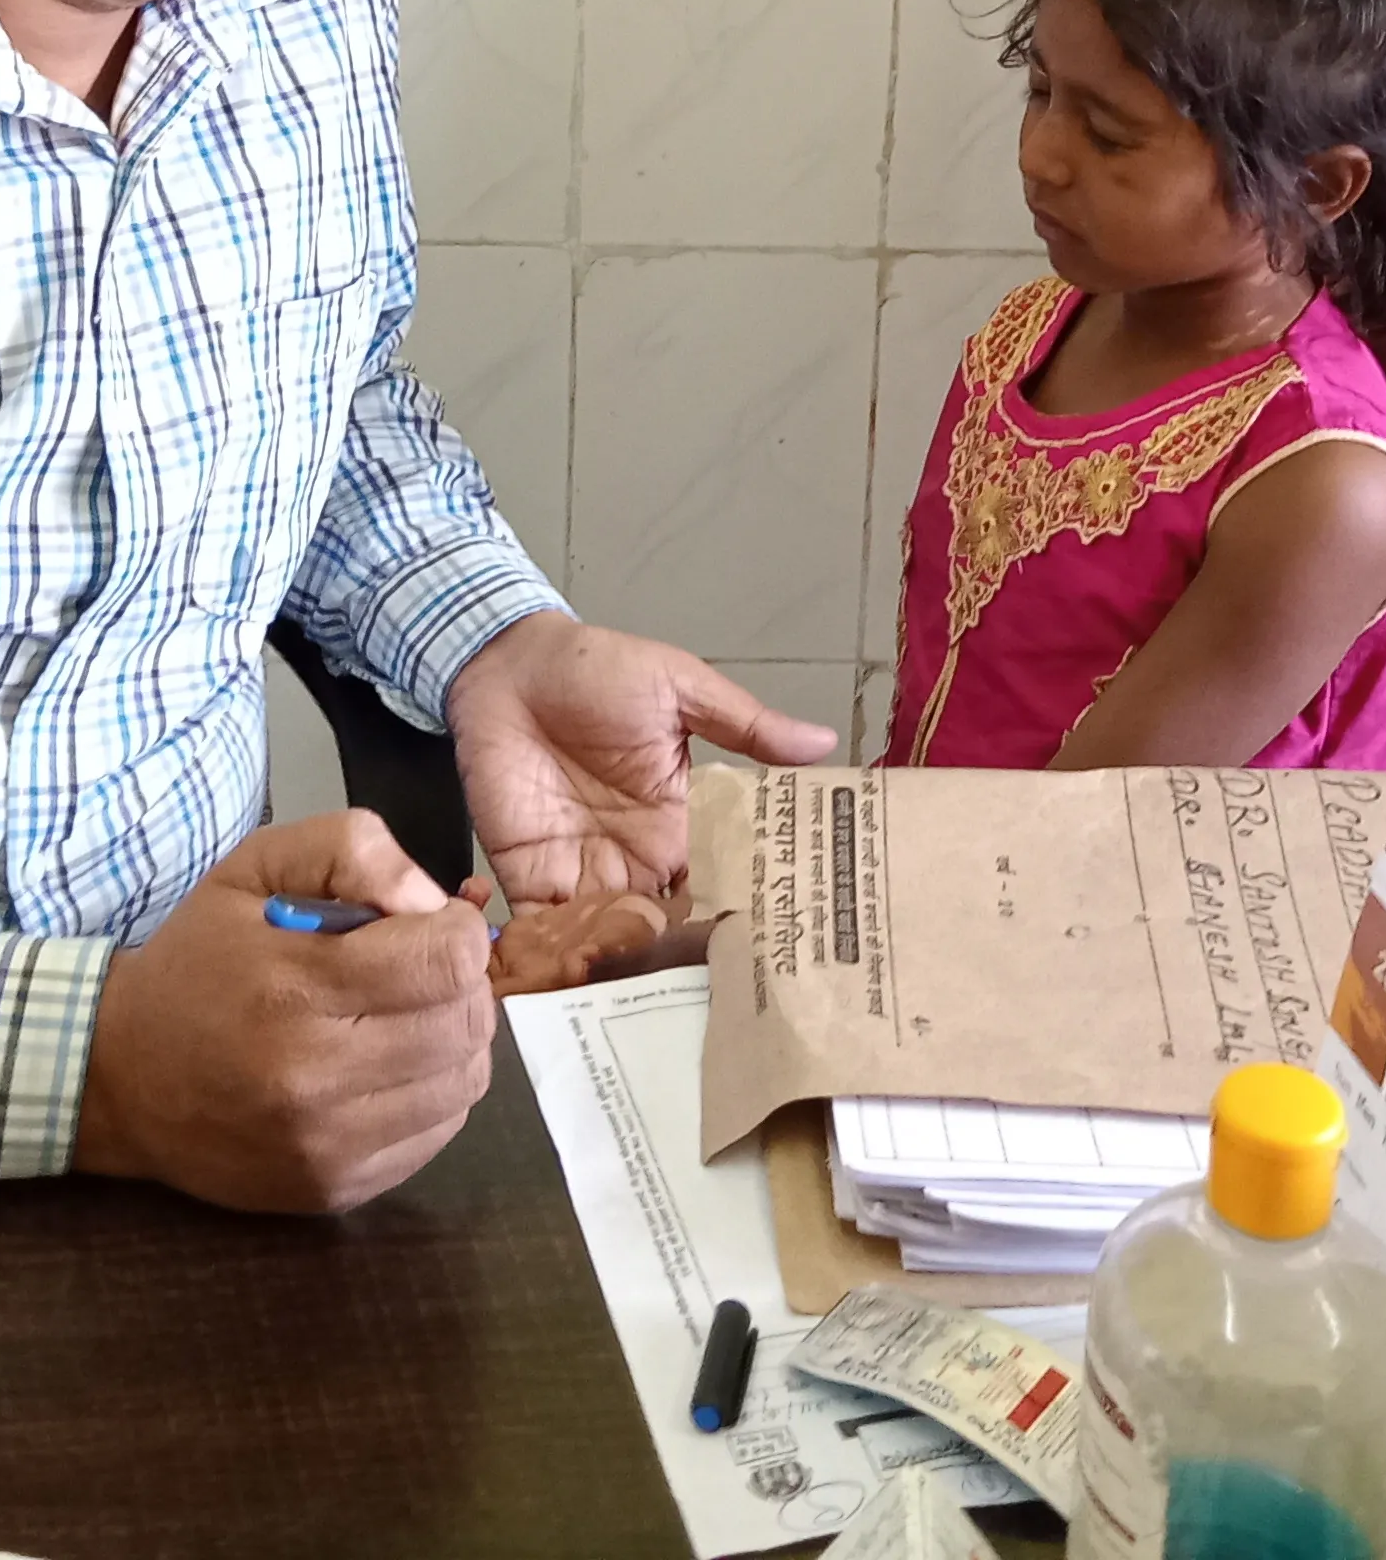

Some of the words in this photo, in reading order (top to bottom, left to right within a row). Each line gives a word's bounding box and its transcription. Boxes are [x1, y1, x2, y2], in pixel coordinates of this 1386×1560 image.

[773, 771, 797, 867] घनश्याम
[1166, 769, 1202, 826] DR.
[1219, 771, 1268, 838] DR.
[769, 875, 804, 978] एसोसिएट
